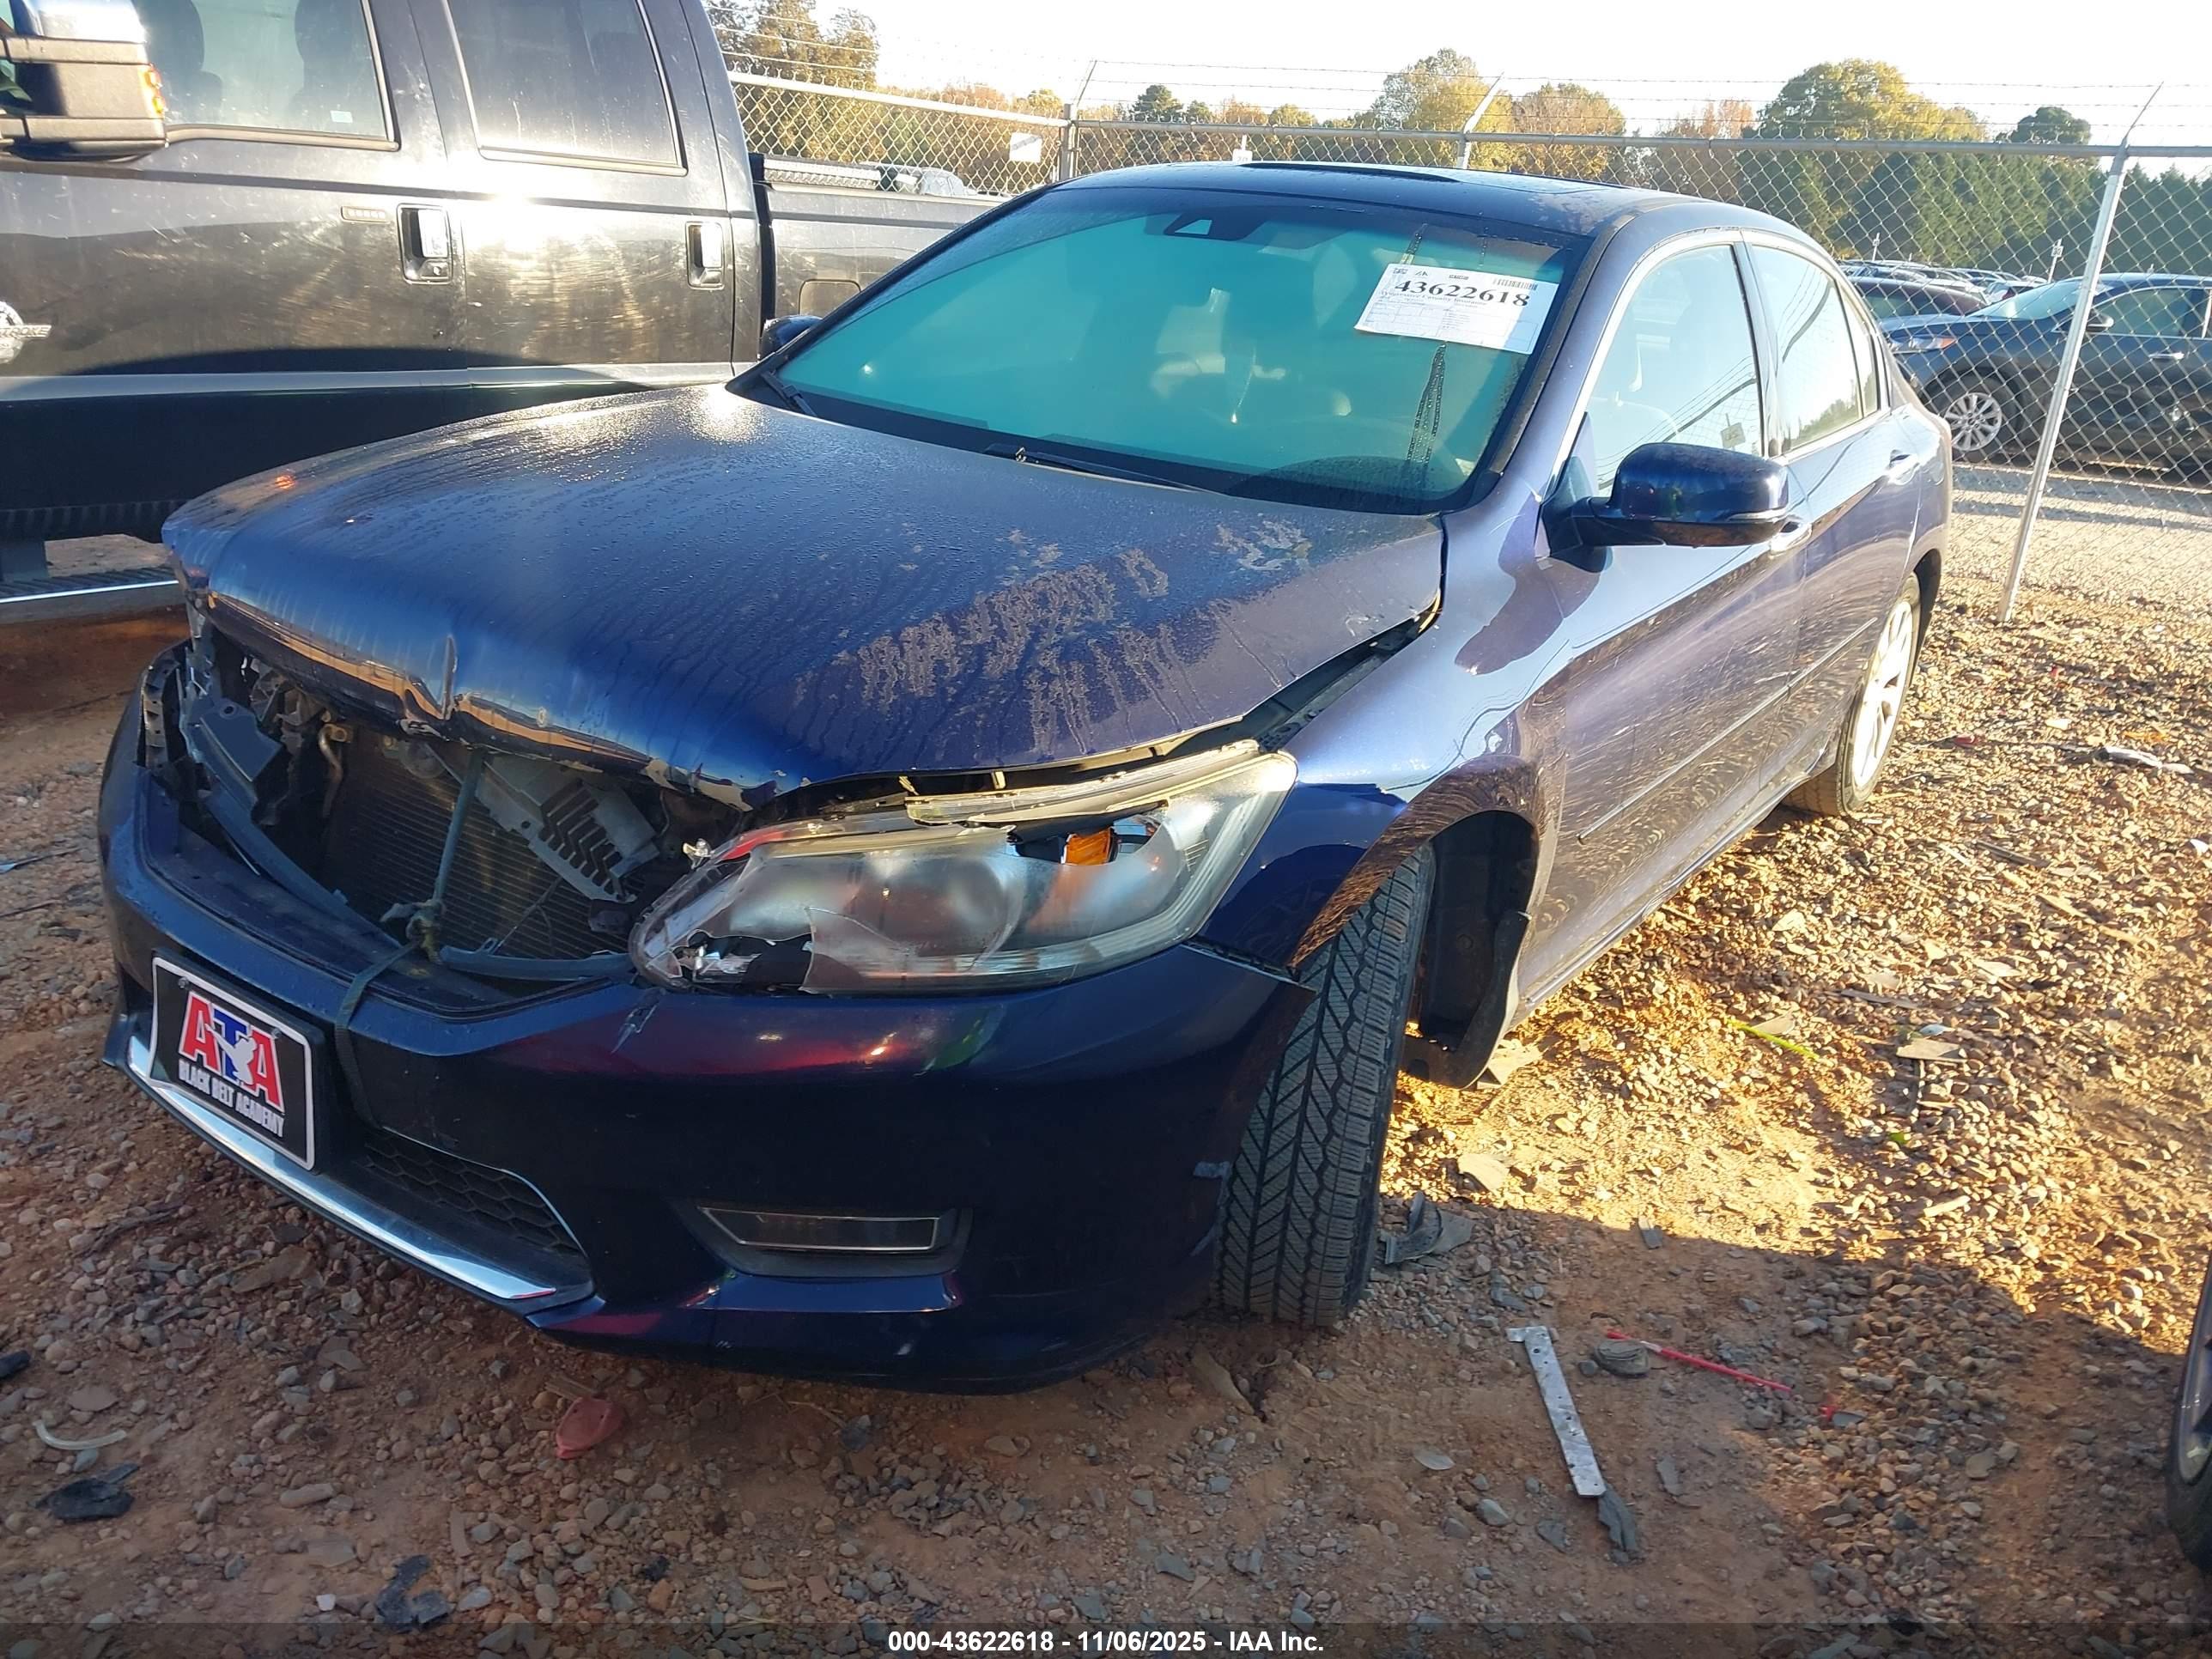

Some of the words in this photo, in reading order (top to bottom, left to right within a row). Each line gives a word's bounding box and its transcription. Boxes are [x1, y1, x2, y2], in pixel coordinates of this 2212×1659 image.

[1395, 279, 1530, 307] 43622618
[179, 991, 284, 1114] ATA
[179, 1060, 210, 1095] BLACK
[211, 1075, 233, 1108] BELT
[236, 1092, 284, 1138] ACADEMY
